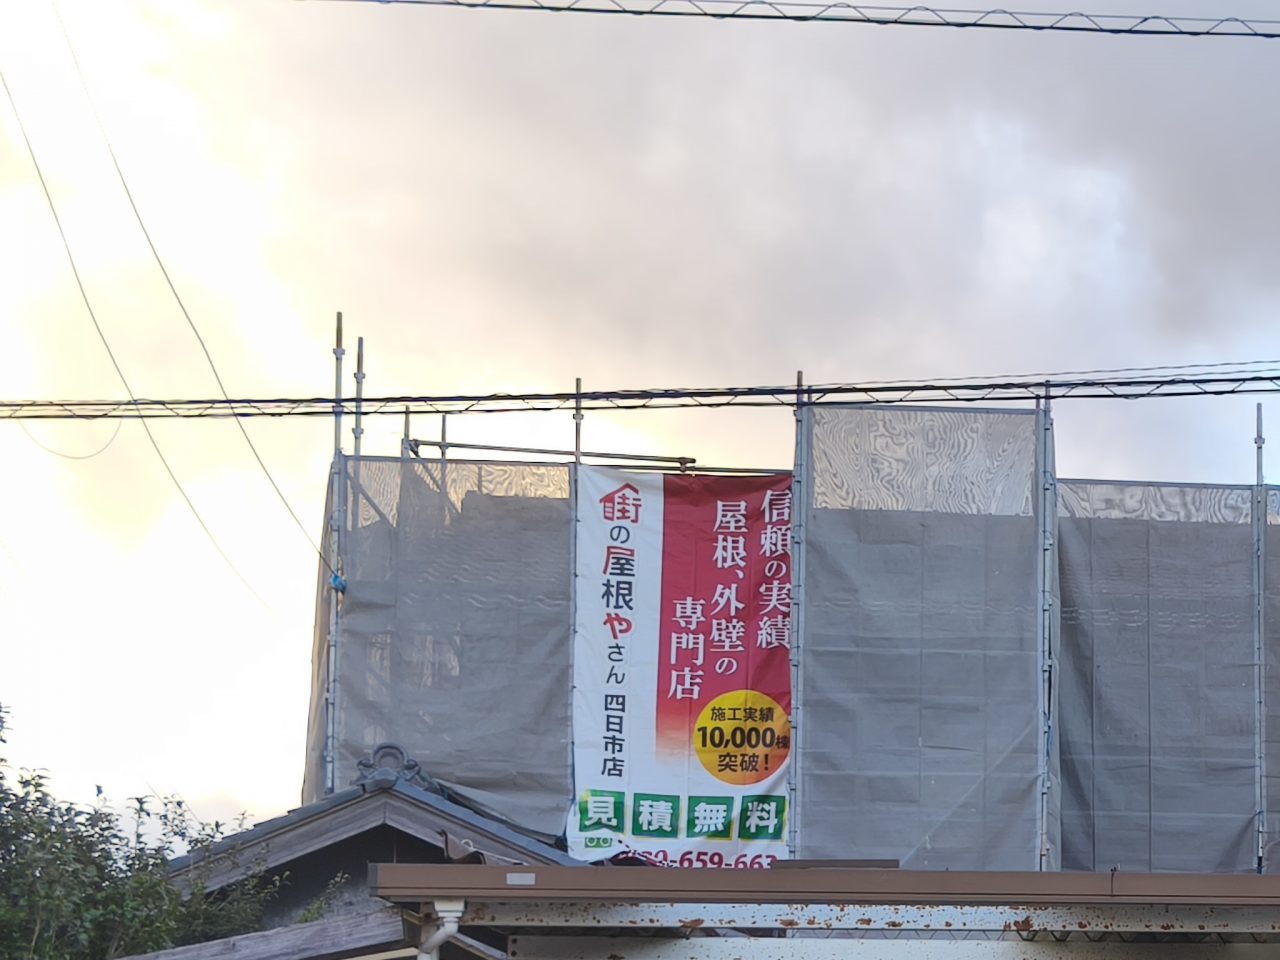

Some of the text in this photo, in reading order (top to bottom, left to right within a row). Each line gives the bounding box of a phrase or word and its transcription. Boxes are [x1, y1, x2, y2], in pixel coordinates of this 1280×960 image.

[599, 482, 641, 777] 街の屋根やさん 四日市店
[709, 500, 748, 675] 屋根、外壁の
[756, 489, 791, 650] 信頼の実績
[667, 596, 706, 700] 専門店
[711, 706, 774, 722] 施工実績
[584, 796, 778, 833] 見積無料
